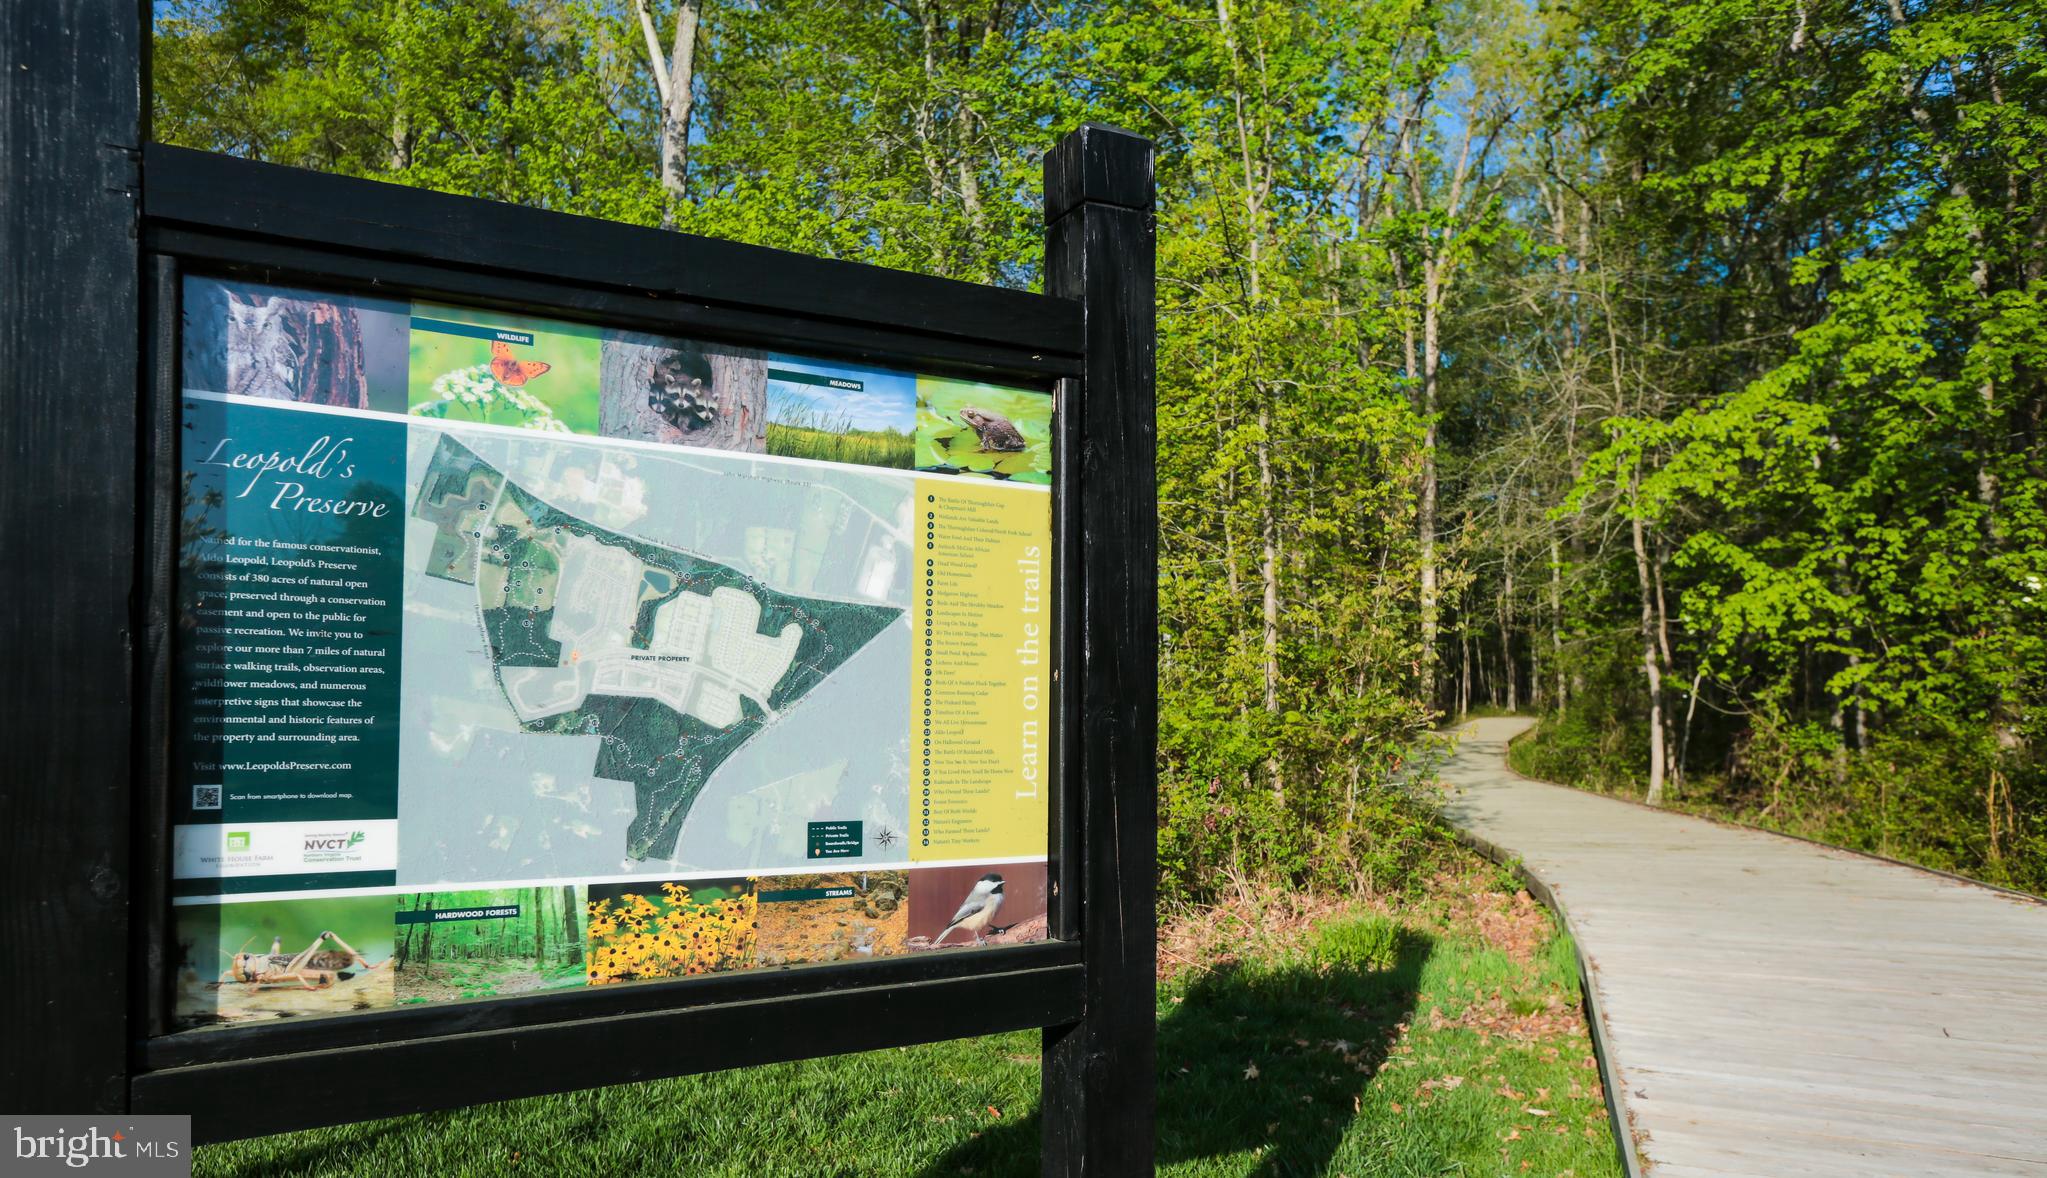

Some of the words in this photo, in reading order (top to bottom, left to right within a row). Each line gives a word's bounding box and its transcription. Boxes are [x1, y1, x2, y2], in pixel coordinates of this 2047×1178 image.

[496, 332, 530, 343] WILDLIFE
[829, 380, 861, 390] MEADOWS
[200, 436, 355, 498] Leopold's
[270, 482, 390, 518] Preserve
[237, 536, 252, 547] for
[254, 537, 270, 548] the
[272, 538, 308, 550] famous
[308, 542, 381, 556] conservationist,
[225, 553, 268, 568] Leopold,
[271, 555, 316, 570] Leopold's
[318, 557, 357, 569] Preserve
[198, 568, 237, 581] consists
[238, 570, 251, 581] of
[251, 571, 270, 582] 380
[271, 575, 296, 584] acres
[297, 574, 309, 584] of
[309, 574, 343, 586] natural
[344, 579, 368, 590] open
[1018, 546, 1041, 612] trails
[229, 589, 277, 604] preserved
[279, 591, 318, 606] through
[327, 593, 386, 606] conservation
[197, 605, 243, 617] easement
[245, 607, 264, 618] and
[266, 610, 290, 621] open
[292, 608, 303, 619] to
[304, 609, 320, 620] the
[322, 610, 351, 624] public
[352, 611, 366, 622] for
[196, 623, 232, 637] passive
[234, 624, 286, 636] recreation.
[288, 626, 304, 637] We
[306, 626, 332, 637] invite
[334, 630, 352, 640] you
[353, 628, 363, 638] to
[196, 640, 233, 654] explore
[254, 645, 280, 653] more
[282, 643, 304, 654] than
[306, 644, 312, 654] 7
[314, 644, 340, 655] miles
[341, 644, 352, 655] of
[353, 645, 385, 656] natural
[1017, 623, 1039, 666] the
[233, 660, 272, 673] walking
[274, 660, 301, 674] trails,
[302, 661, 358, 672] observation
[359, 665, 385, 676] areas,
[249, 678, 298, 692] meadows,
[299, 679, 318, 689] and
[320, 682, 366, 690] numerous
[254, 695, 279, 708] signs
[280, 696, 300, 706] that
[302, 696, 346, 706] showcase
[347, 696, 362, 707] the
[1023, 676, 1039, 711] on
[194, 713, 266, 723] environmental
[268, 713, 286, 724] and
[288, 713, 324, 724] historic
[326, 713, 362, 724] features
[364, 714, 375, 724] of
[212, 731, 255, 744] property
[256, 731, 276, 741] and
[277, 731, 337, 744] surrounding
[219, 759, 352, 773] www.LeopoldsPreserve.com
[1016, 720, 1038, 800] Learn
[262, 792, 299, 801] smartphone
[304, 840, 346, 850] NVCT
[435, 910, 484, 920] HARDWOOD
[486, 908, 517, 916] FORESTS
